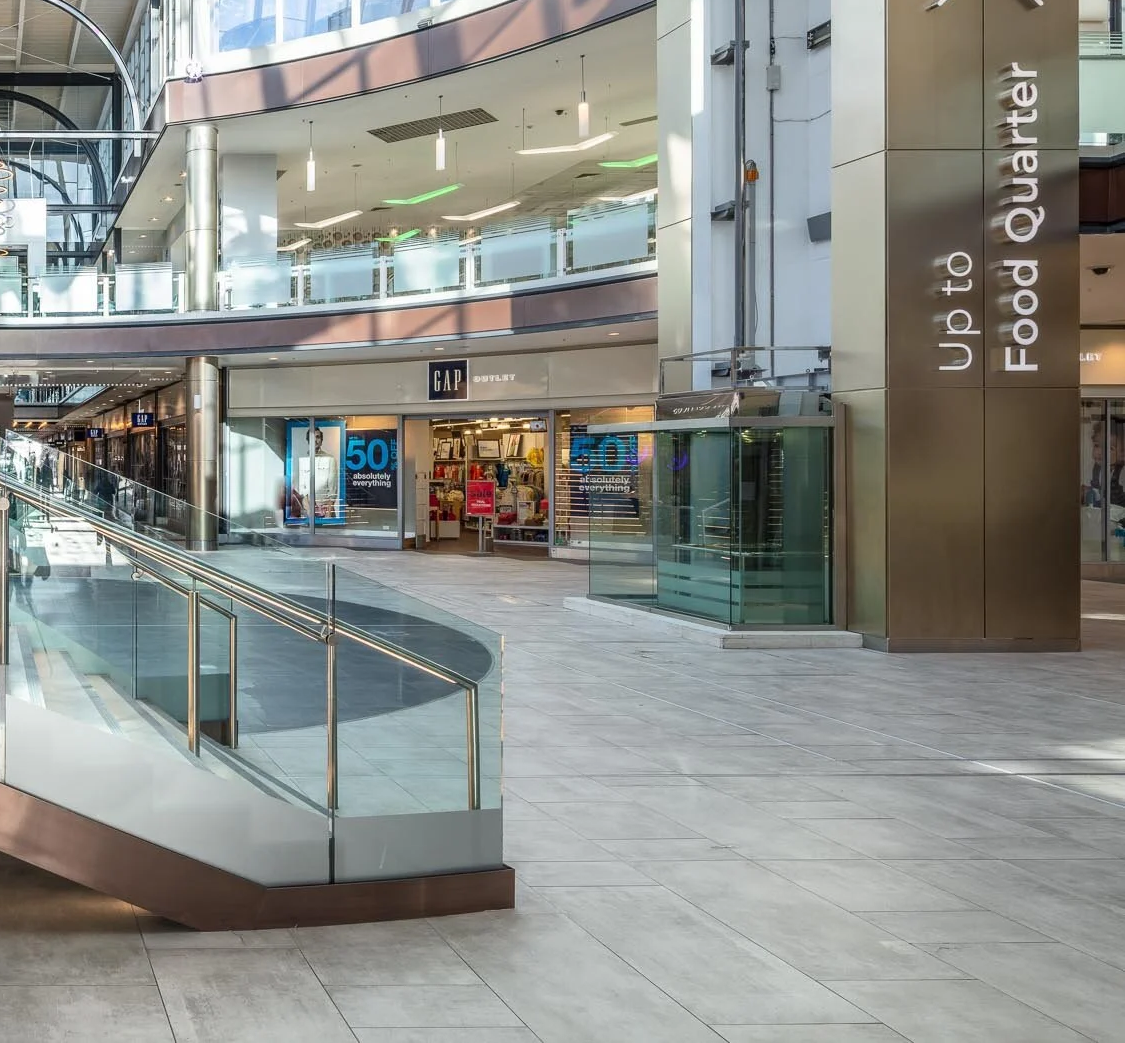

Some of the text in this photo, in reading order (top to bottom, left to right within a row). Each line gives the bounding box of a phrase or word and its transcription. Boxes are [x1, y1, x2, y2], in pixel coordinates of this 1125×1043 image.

[1003, 62, 1045, 372] Food Quarter
[938, 252, 981, 371] Up to
[433, 369, 516, 392] GAP OUTLET
[346, 438, 389, 471] 50
[352, 479, 392, 488] everything
[353, 472, 391, 480] absolutely
[578, 482, 631, 493] everything
